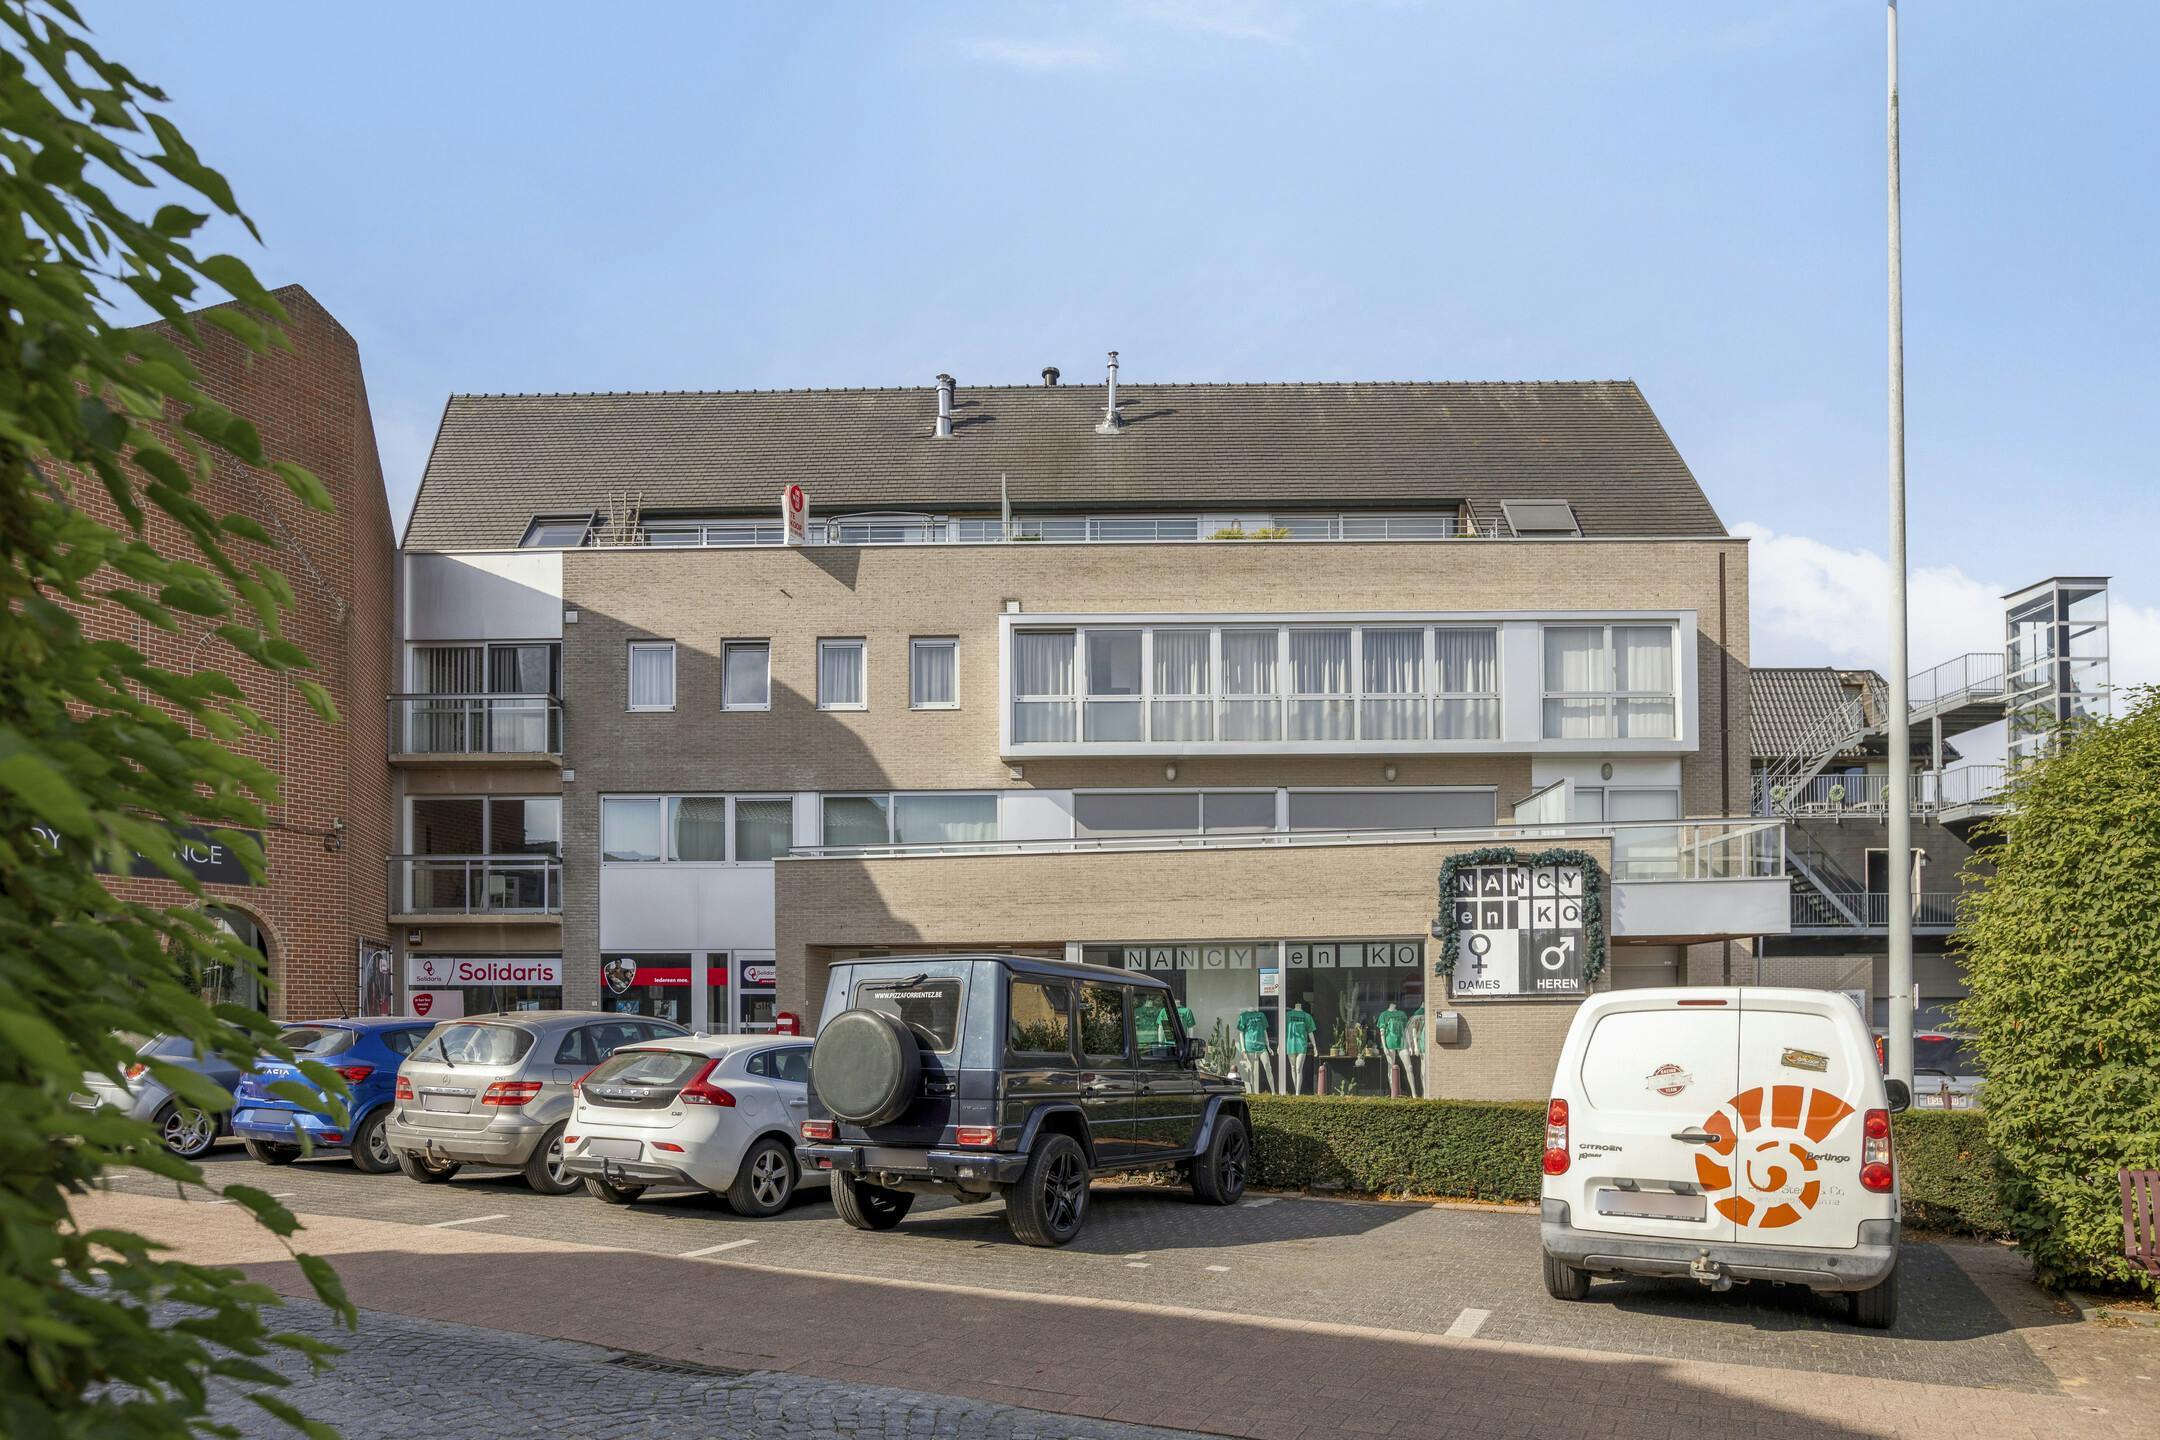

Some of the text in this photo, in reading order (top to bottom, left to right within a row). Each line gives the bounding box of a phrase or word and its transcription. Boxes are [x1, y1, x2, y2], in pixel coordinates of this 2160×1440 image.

[1459, 872, 1577, 892] NANCY
[1460, 905, 1578, 925] en KO
[1129, 946, 1414, 967] NANCY en KO
[459, 962, 554, 981] Solidaris
[1458, 980, 1500, 990] DAMES
[1537, 978, 1579, 989] HEREN
[1806, 1152, 1851, 1163] Berlingo
